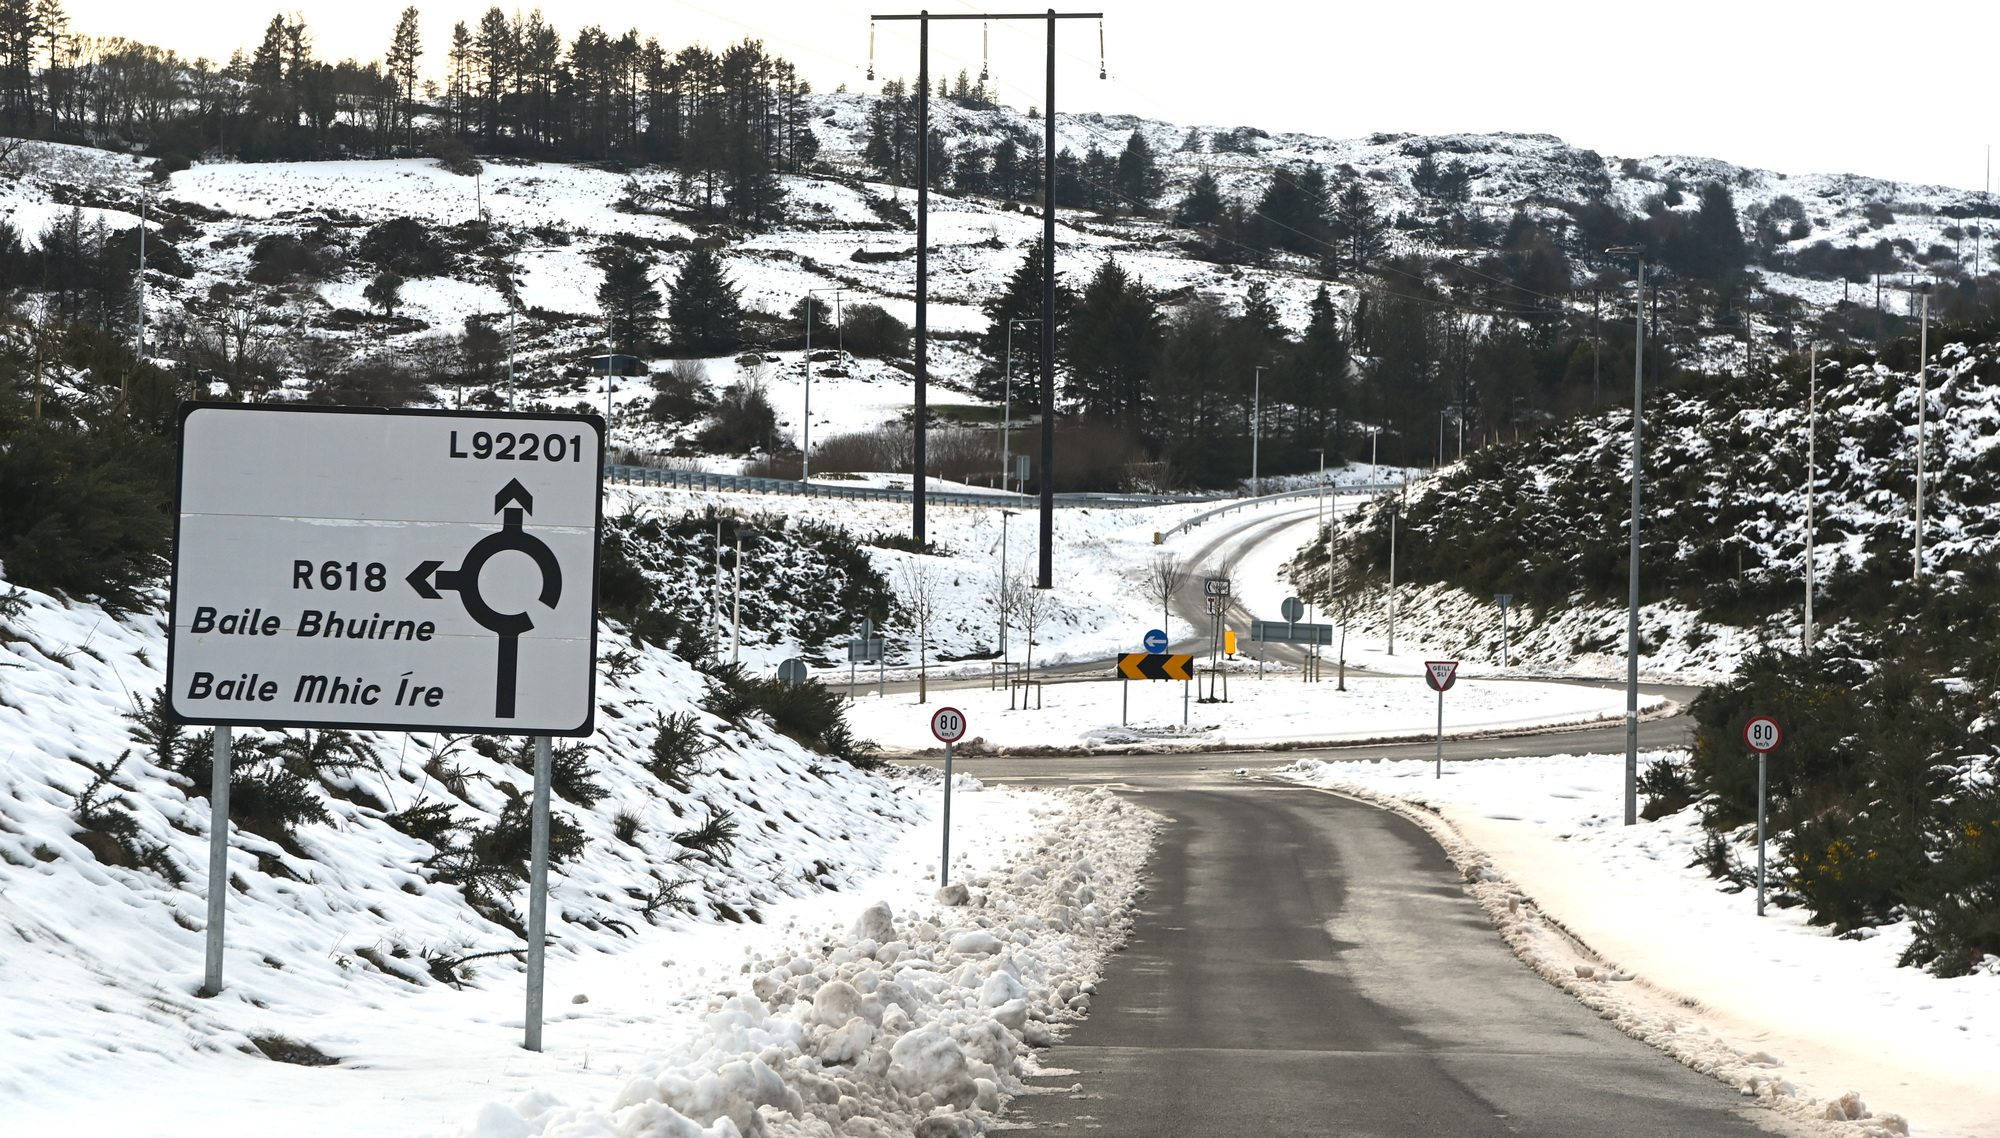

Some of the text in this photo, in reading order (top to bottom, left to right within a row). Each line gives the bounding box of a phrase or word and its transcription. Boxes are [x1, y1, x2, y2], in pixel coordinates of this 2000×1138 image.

[449, 430, 582, 463] L92201
[292, 559, 387, 592] R618
[190, 606, 436, 642] Baile Bhuirne
[187, 671, 444, 708] Baile Mhic Íre
[940, 715, 957, 730] 80
[1754, 724, 1772, 740] 80
